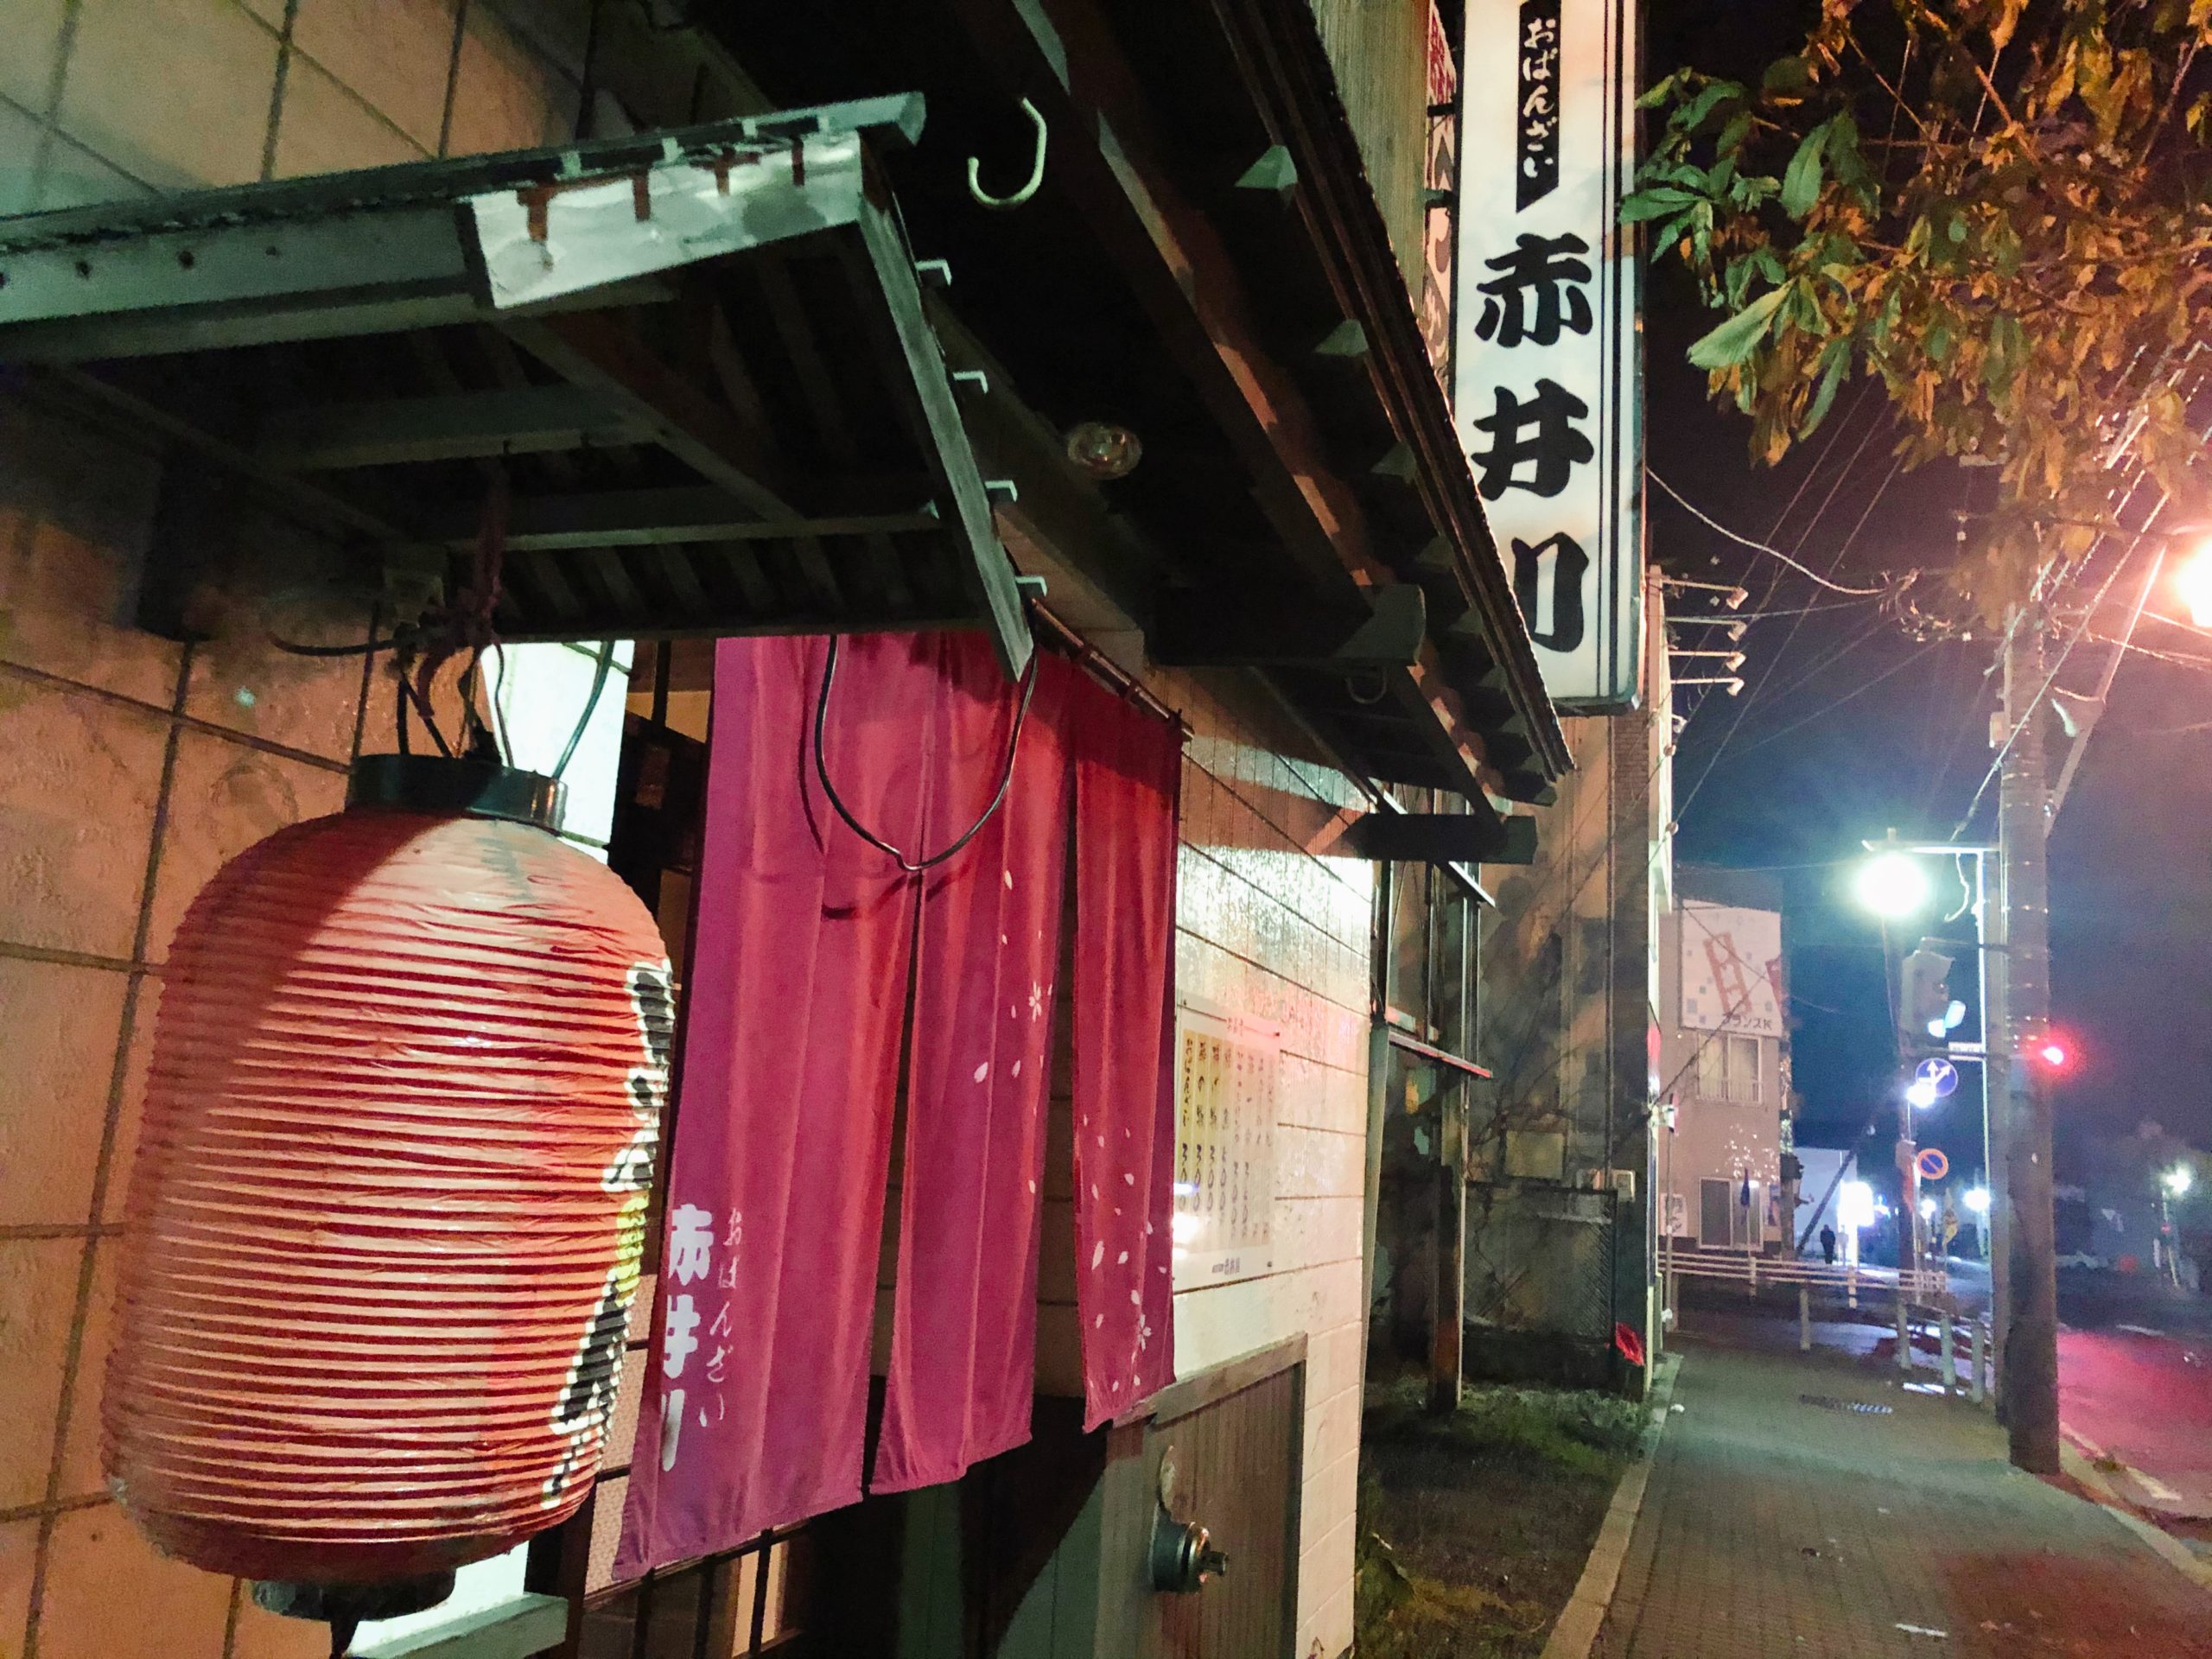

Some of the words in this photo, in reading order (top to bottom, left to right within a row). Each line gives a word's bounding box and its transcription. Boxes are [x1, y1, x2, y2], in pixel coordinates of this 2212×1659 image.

[1522, 17, 1558, 179] おばんざい
